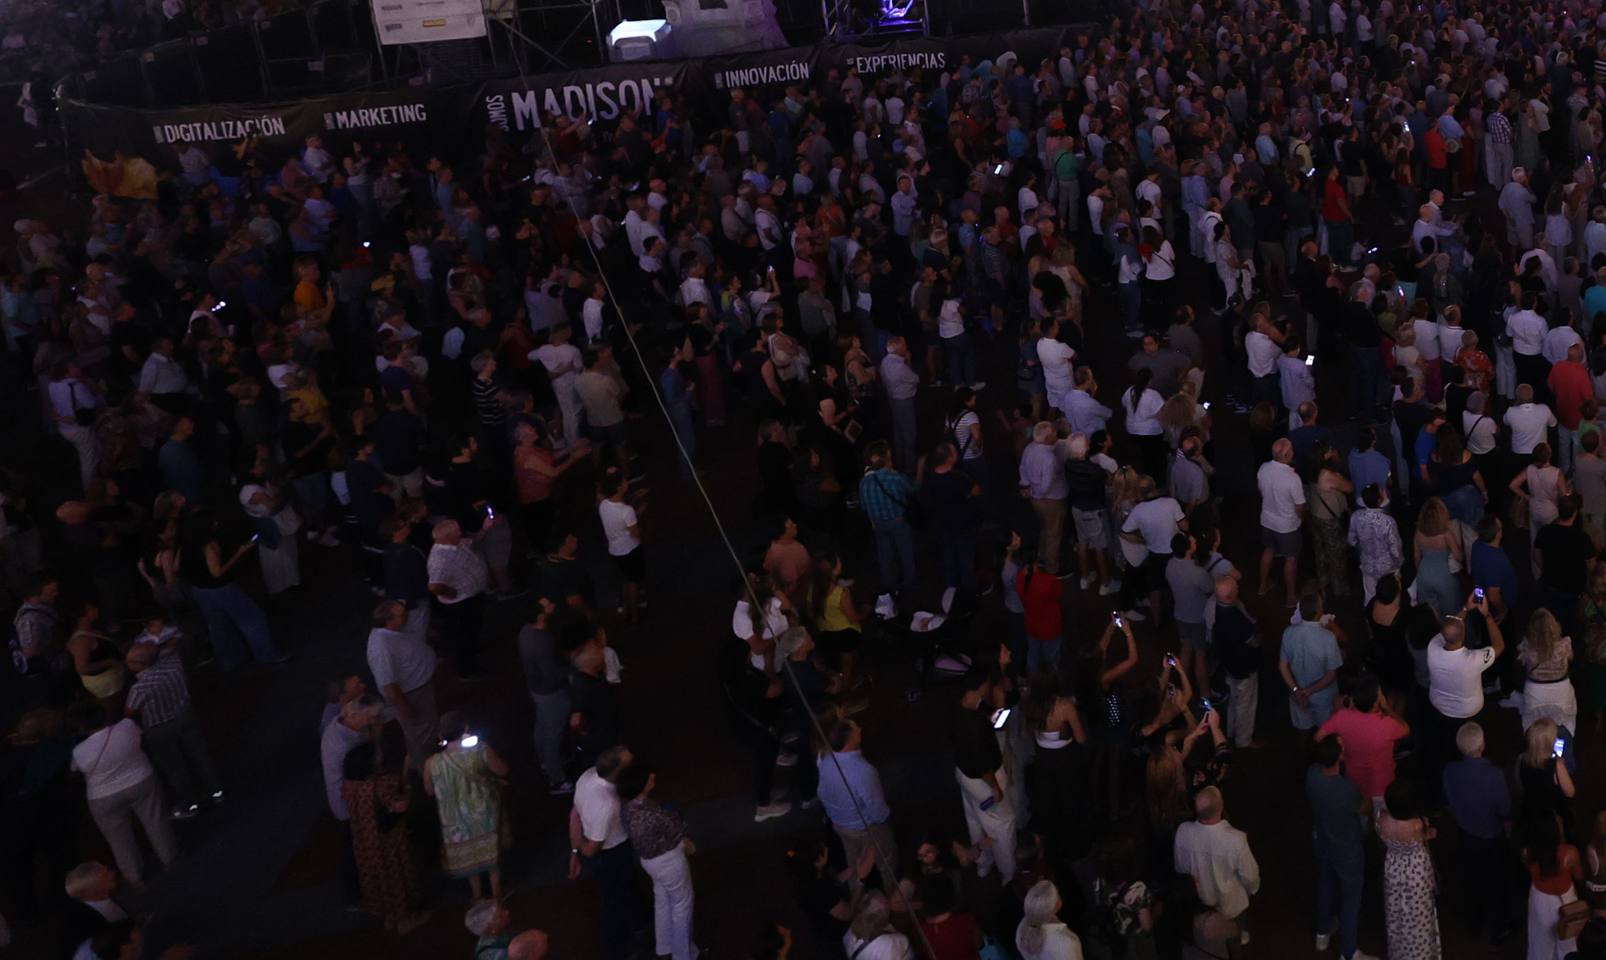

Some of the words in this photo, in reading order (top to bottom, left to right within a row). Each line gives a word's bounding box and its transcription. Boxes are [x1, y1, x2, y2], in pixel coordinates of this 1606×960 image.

[725, 60, 810, 89] INNOVACIÓN
[856, 51, 946, 74] EXPERIENCIAS
[335, 103, 427, 130] MARKETING
[511, 78, 655, 132] MADISON
[164, 115, 286, 144] DIGITALIZACIÓN
